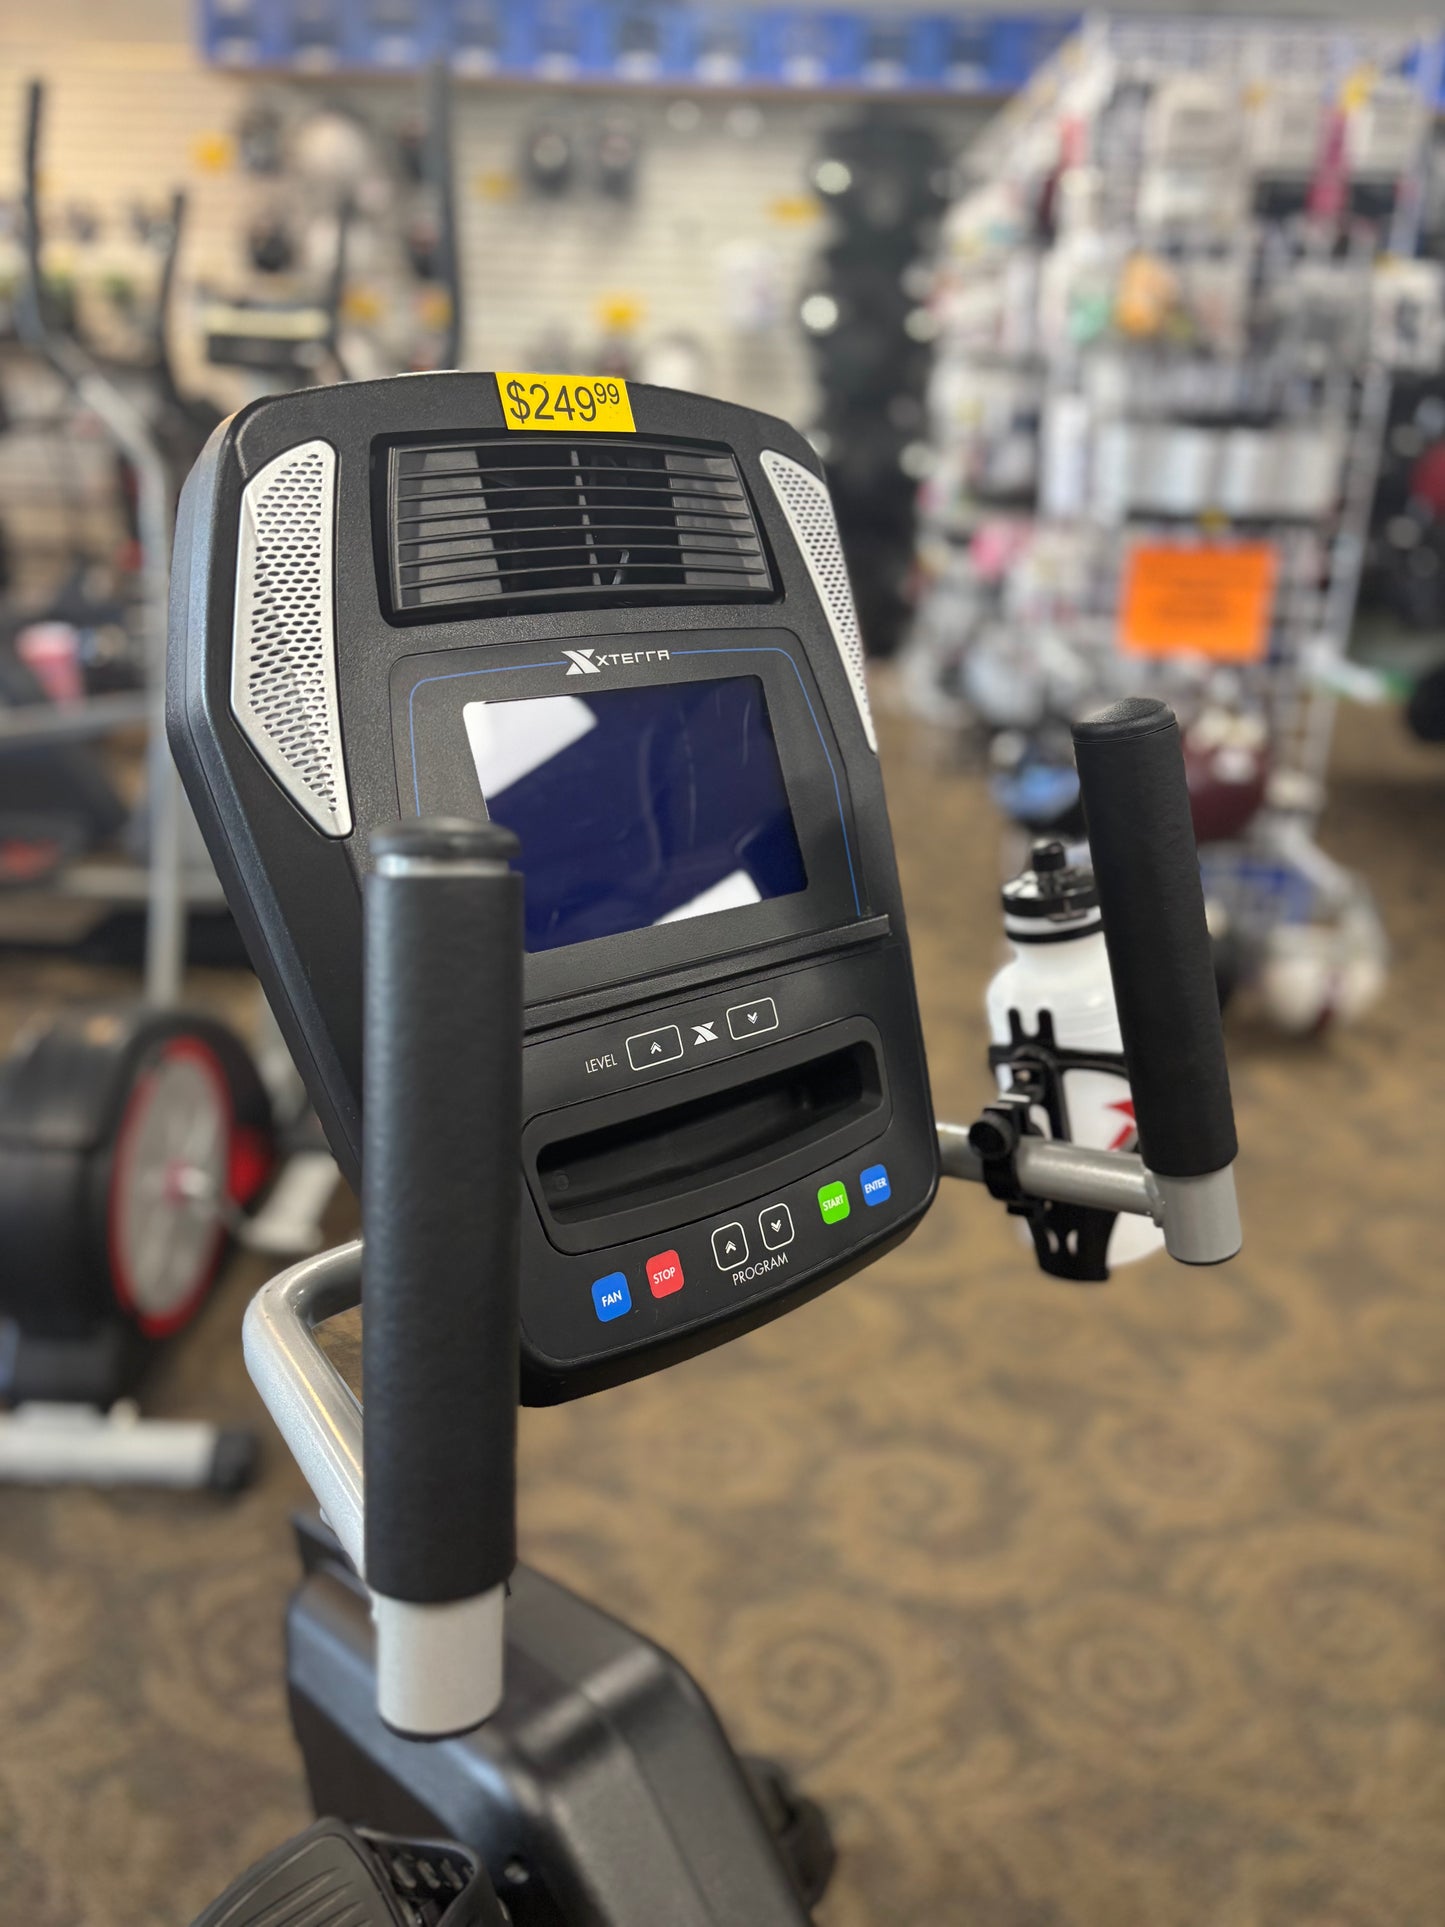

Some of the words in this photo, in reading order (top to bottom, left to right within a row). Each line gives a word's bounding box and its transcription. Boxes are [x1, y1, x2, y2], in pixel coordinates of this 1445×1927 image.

[595, 649, 671, 667] XTERRA
[585, 1053, 618, 1074] LEVEL
[864, 1177, 888, 1195] ENTER
[822, 1194, 844, 1212] START
[653, 1266, 676, 1285] STOP
[732, 1251, 789, 1286] PROGRAM
[601, 1289, 623, 1308] FAN
